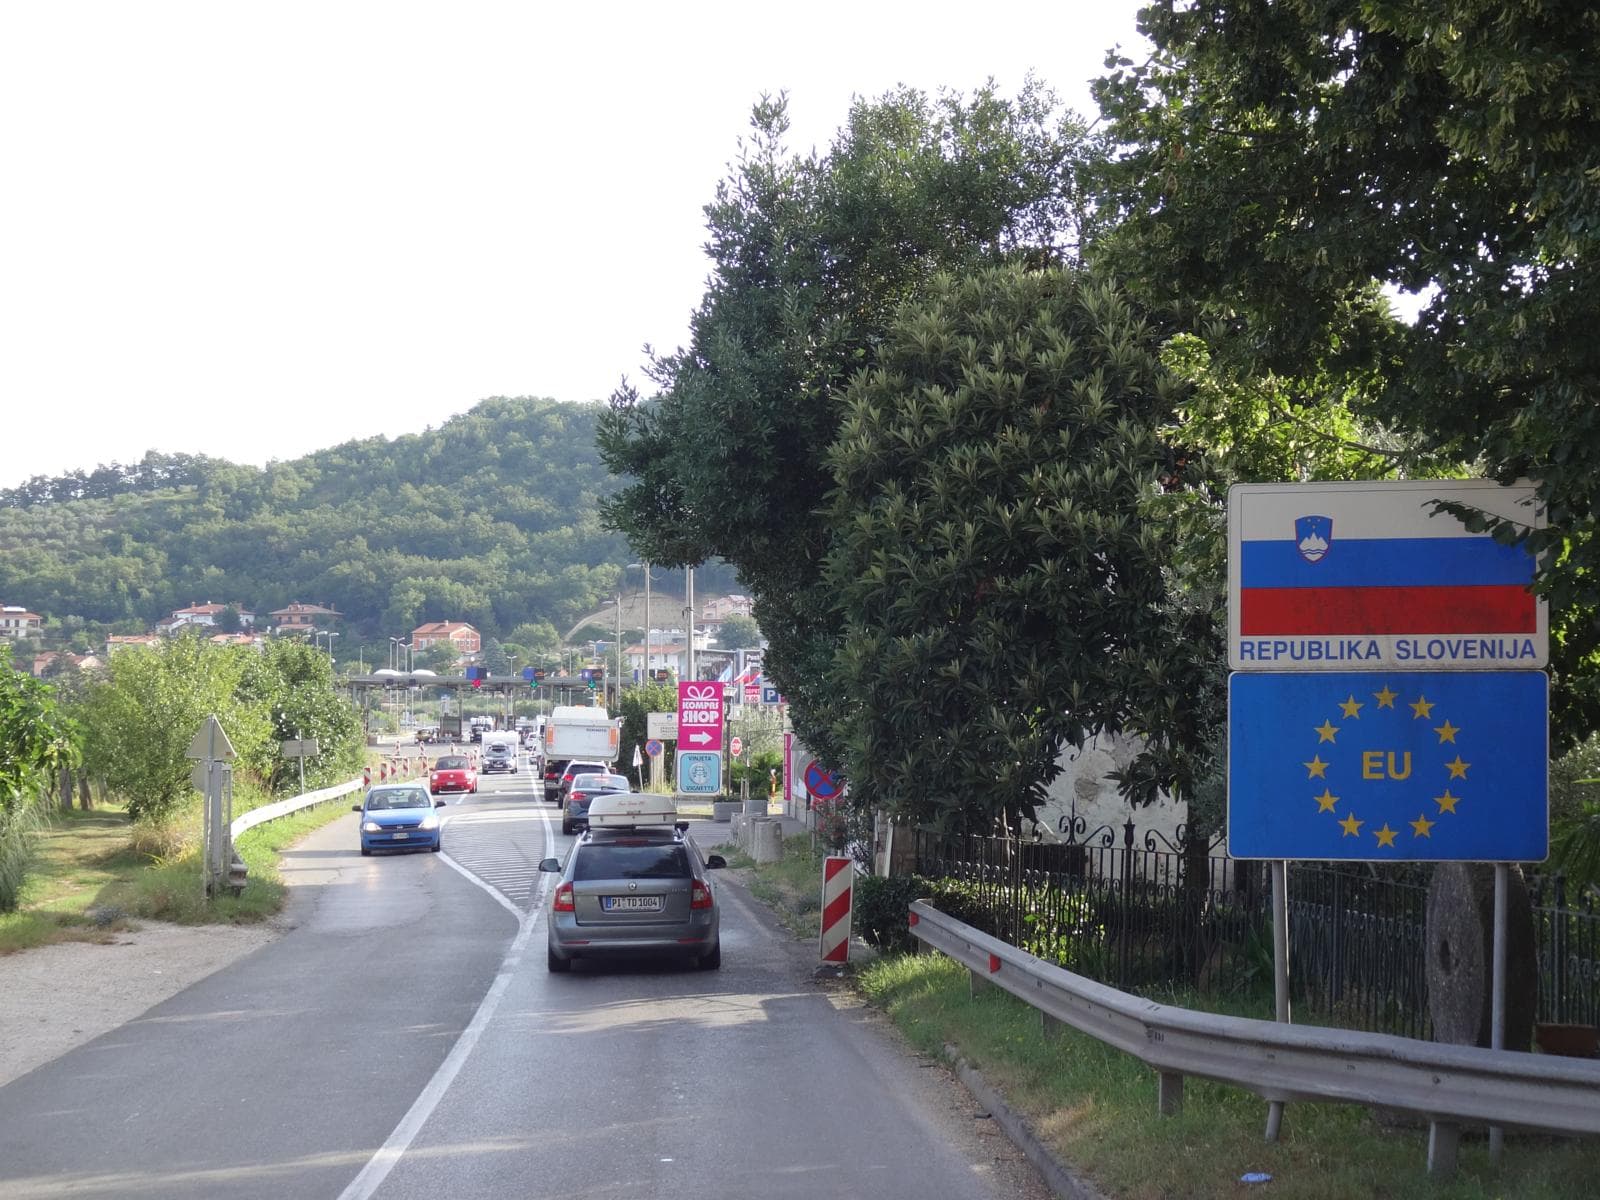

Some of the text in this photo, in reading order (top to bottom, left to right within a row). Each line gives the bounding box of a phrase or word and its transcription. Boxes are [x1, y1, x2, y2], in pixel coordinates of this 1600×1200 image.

[1240, 639, 1536, 660] REPUBLIKA SLOVENIJA
[767, 690, 776, 700] P
[682, 710, 720, 723] SHOP
[1362, 751, 1412, 780] EU
